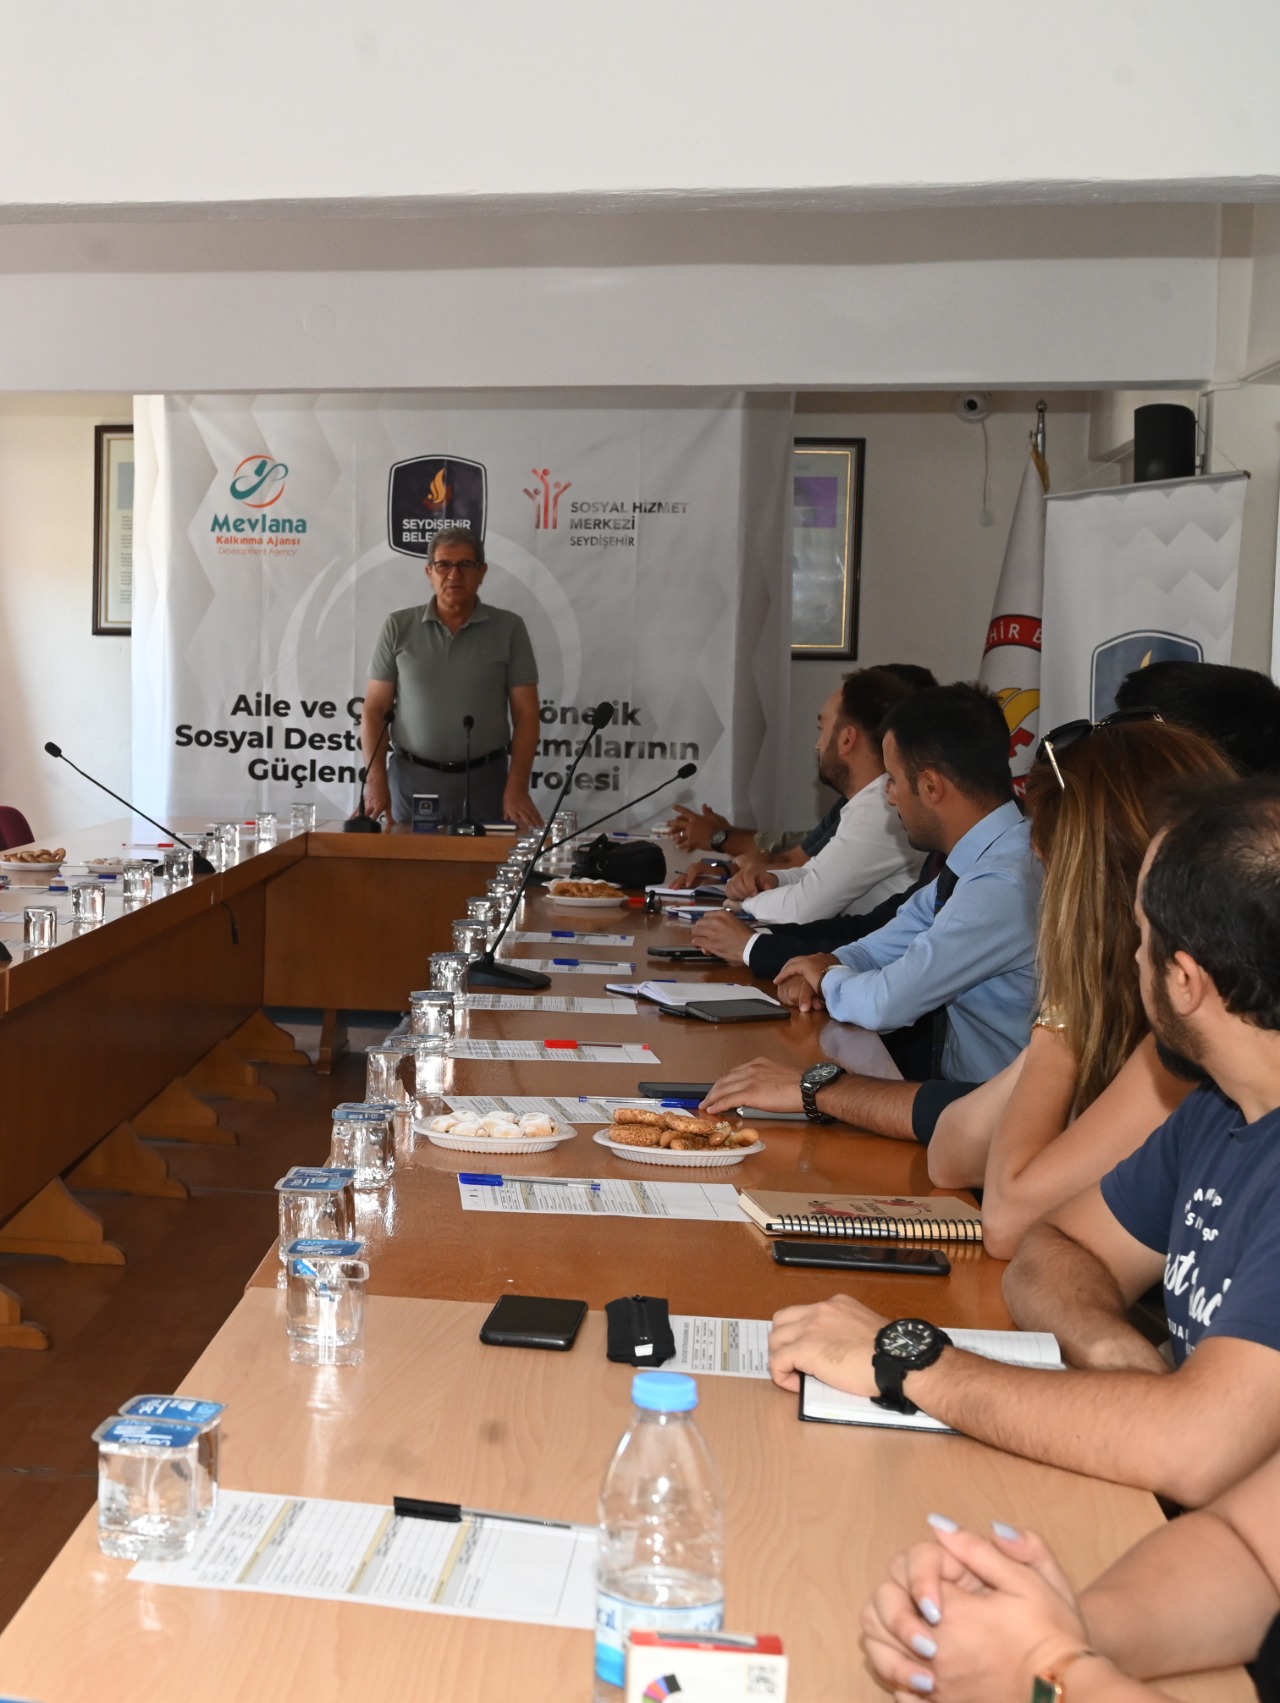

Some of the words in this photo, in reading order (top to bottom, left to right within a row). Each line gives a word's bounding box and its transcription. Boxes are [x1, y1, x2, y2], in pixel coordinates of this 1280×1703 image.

[571, 502, 628, 514] SOSYAL
[633, 501, 689, 514] HİZMET
[210, 513, 307, 534] Mevlana
[570, 516, 635, 530] MERKEZİ
[216, 535, 263, 546] Kalkınma
[267, 536, 301, 547] Ajansı
[570, 535, 635, 549] SEYDİŞEHİR
[230, 692, 292, 718] Aile
[300, 700, 337, 719] ve
[539, 700, 642, 726] öneik
[175, 724, 274, 753] Sosyal
[531, 764, 620, 796] rojesi
